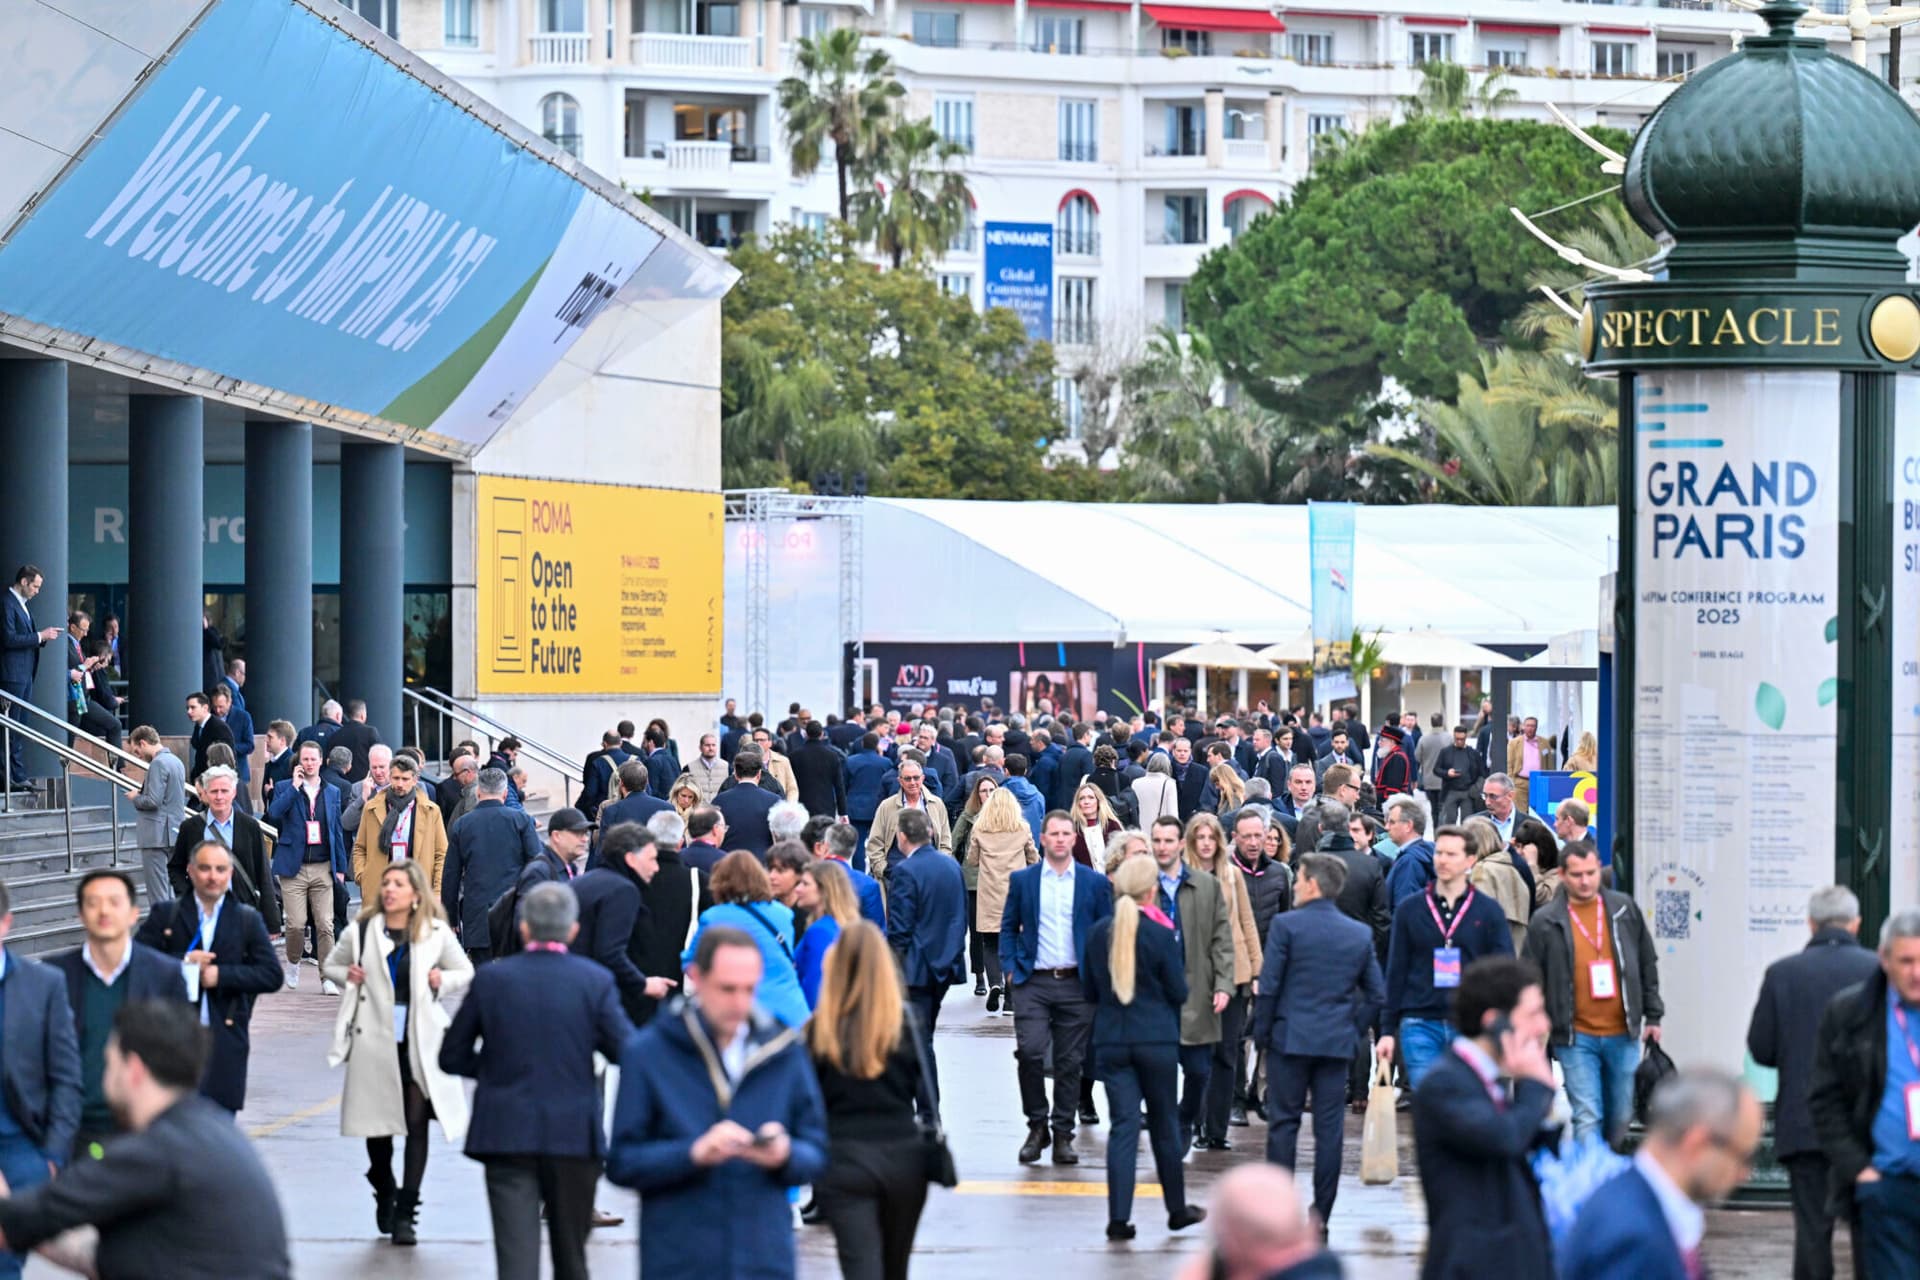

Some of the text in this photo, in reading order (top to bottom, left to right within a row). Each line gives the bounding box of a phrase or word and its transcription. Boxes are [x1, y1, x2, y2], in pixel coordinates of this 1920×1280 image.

[85, 86, 313, 293] Welcome
[251, 177, 356, 304] to
[986, 229, 1050, 248] NEWMARK
[285, 185, 461, 339] MIPIM
[1000, 268, 1035, 282] Global
[986, 282, 1048, 298] Commercial
[1601, 307, 1842, 347] SPECTACLE
[1647, 461, 1817, 507] GRAND
[531, 500, 573, 534] ROMA
[1652, 513, 1806, 559] PARIS
[531, 551, 573, 597] Open
[531, 595, 577, 632] to the
[1671, 591, 1742, 604] CONFERENCE
[1748, 591, 1826, 604] PROGRAM
[1697, 608, 1741, 624] 2025
[531, 638, 581, 674] Future
